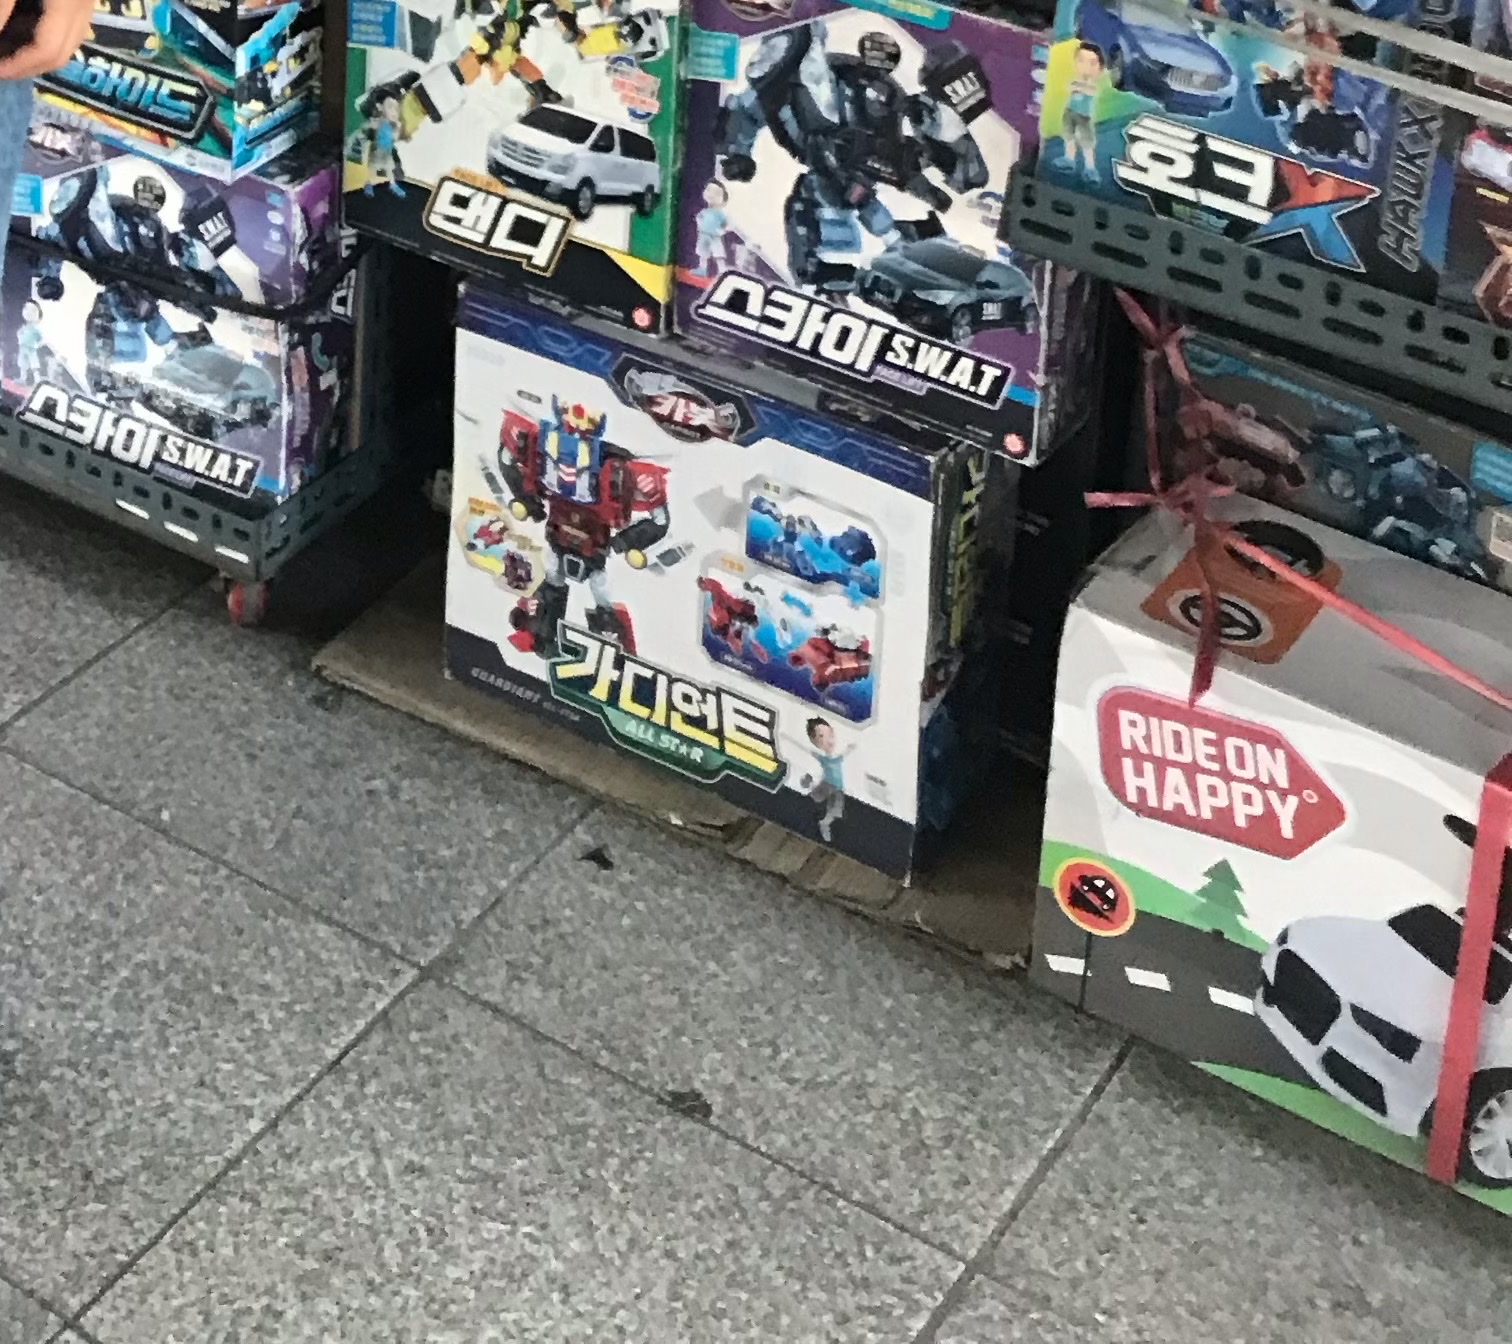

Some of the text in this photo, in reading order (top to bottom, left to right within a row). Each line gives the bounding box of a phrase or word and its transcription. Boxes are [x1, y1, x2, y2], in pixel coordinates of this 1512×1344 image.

[433, 182, 563, 270] 댄디
[698, 278, 1004, 395] 스카이 S.W.A.T
[20, 386, 160, 472] 스카이
[624, 717, 706, 765] ALL STAR
[1117, 708, 1289, 789] RIDE ON
[1121, 756, 1300, 840] HAPPY
